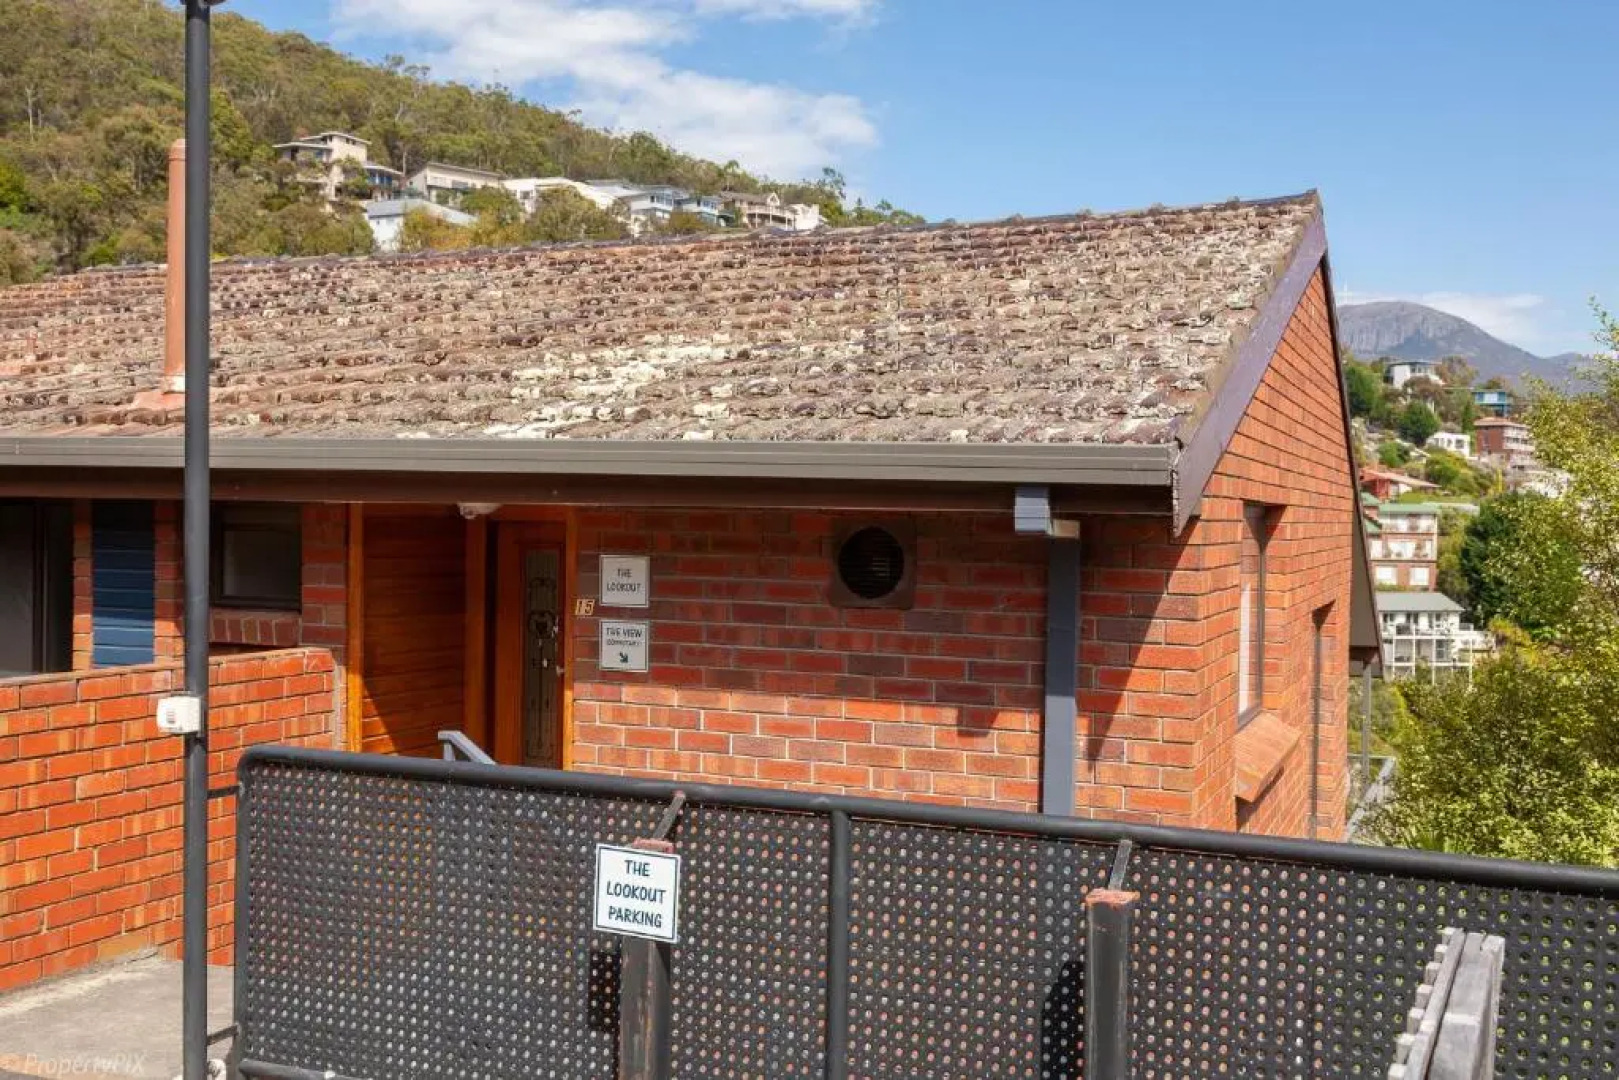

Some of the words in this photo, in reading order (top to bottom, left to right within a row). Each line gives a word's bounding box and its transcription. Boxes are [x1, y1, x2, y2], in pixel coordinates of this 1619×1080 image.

[617, 568, 632, 578] THE
[606, 582, 641, 592] LOOKOUT
[576, 599, 594, 615] 15
[624, 859, 650, 877] THE
[606, 881, 667, 904] LOOKOUT
[608, 905, 662, 928] PARKING
